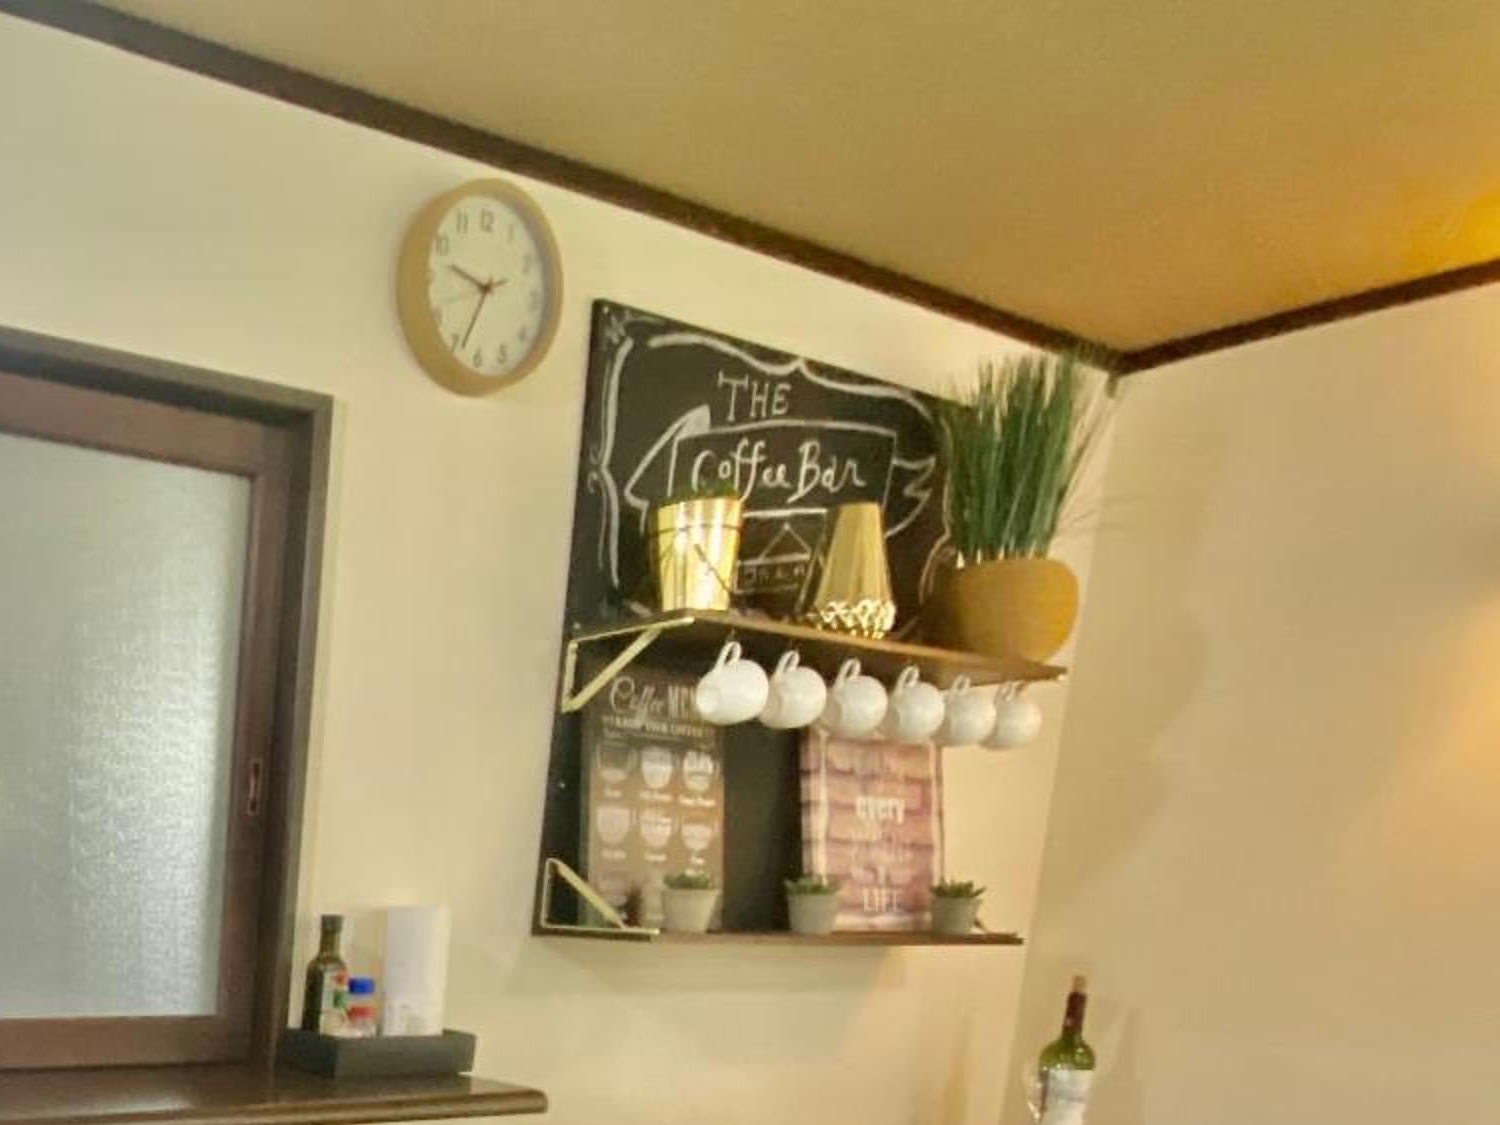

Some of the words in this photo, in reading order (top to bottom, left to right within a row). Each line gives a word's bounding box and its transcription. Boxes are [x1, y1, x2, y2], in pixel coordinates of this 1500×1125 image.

[480, 208, 495, 233] 12
[717, 370, 792, 422] THE
[691, 437, 792, 502] Coffee
[786, 440, 867, 504] Bar
